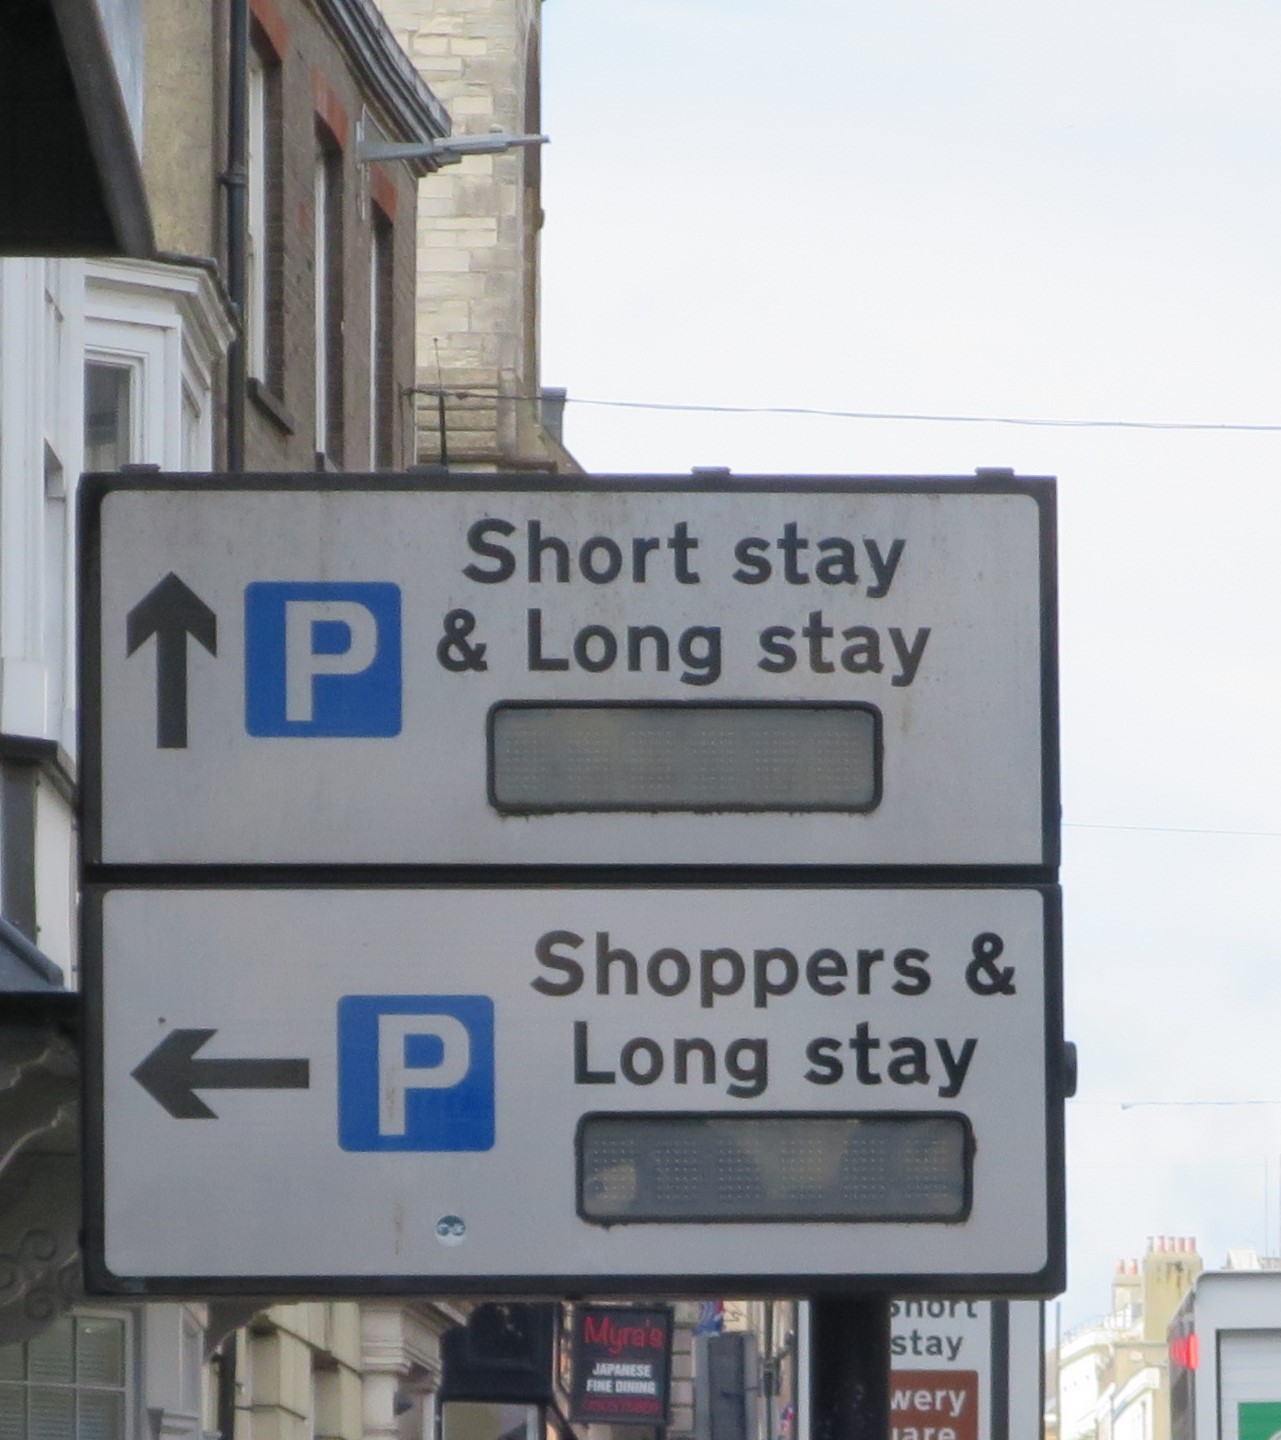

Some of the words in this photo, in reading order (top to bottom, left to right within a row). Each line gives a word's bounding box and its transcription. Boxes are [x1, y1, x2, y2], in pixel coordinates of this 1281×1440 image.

[461, 517, 701, 585] Short
[731, 521, 907, 599] stay
[284, 600, 380, 723] P
[435, 608, 488, 674] &
[527, 608, 723, 686] Long
[756, 610, 932, 687] stay
[529, 930, 933, 1008] Shoppers
[964, 931, 1017, 996] &
[378, 1013, 471, 1136] P
[572, 1020, 769, 1098] Long
[803, 1021, 979, 1098] stay
[584, 1316, 664, 1355] Myra's
[592, 1362, 652, 1378] JAPANESE
[891, 1328, 964, 1362] stay
[586, 1379, 613, 1393] FINE
[615, 1380, 656, 1394] DINING
